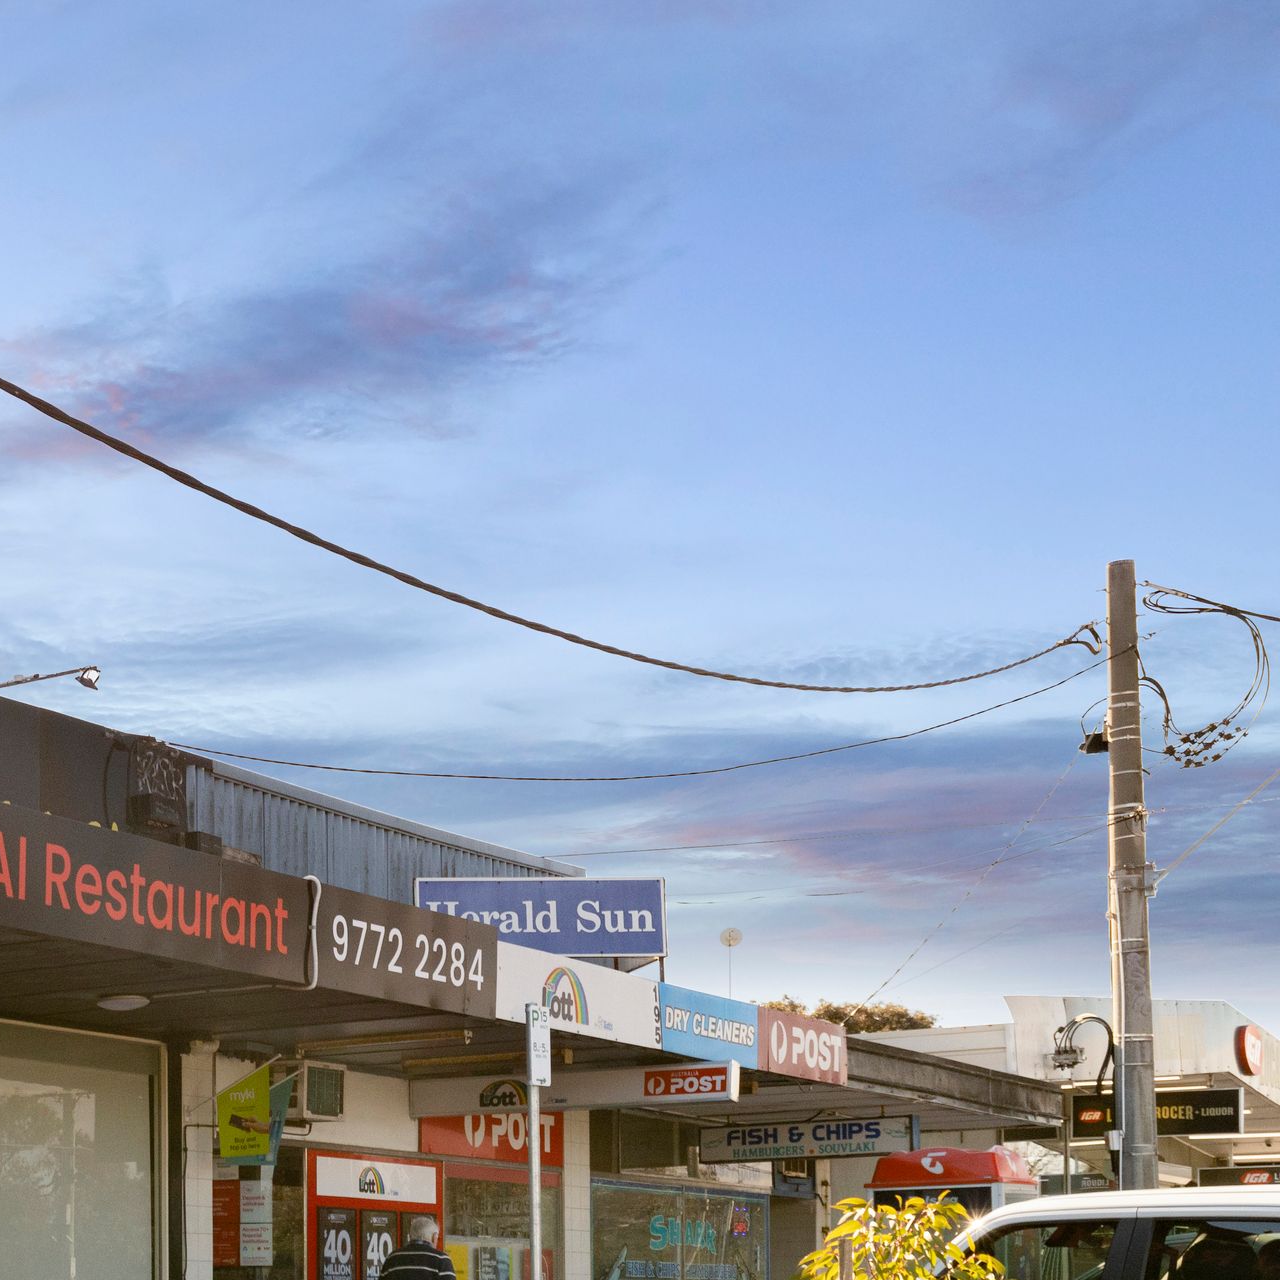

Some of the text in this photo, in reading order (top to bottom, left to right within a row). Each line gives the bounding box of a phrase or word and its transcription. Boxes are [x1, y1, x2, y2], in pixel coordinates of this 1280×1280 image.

[44, 842, 289, 956] Restaurant
[576, 900, 656, 933] Sun
[332, 915, 485, 991] 9772 2284
[665, 1006, 755, 1047] DRY CLEANERS
[792, 1027, 841, 1072] POST
[670, 1075, 726, 1093] POST
[229, 1088, 255, 1104] myki
[1080, 1111, 1102, 1121] IGA
[1155, 1106, 1234, 1121] ROCER LIQUOR
[492, 1113, 555, 1153] POT
[727, 1121, 881, 1146] FISH & CHIPS
[733, 1142, 875, 1159] HAMBURGERS SOUVLAKI
[1244, 1172, 1269, 1183] IGA
[323, 1264, 351, 1275] MILLION
